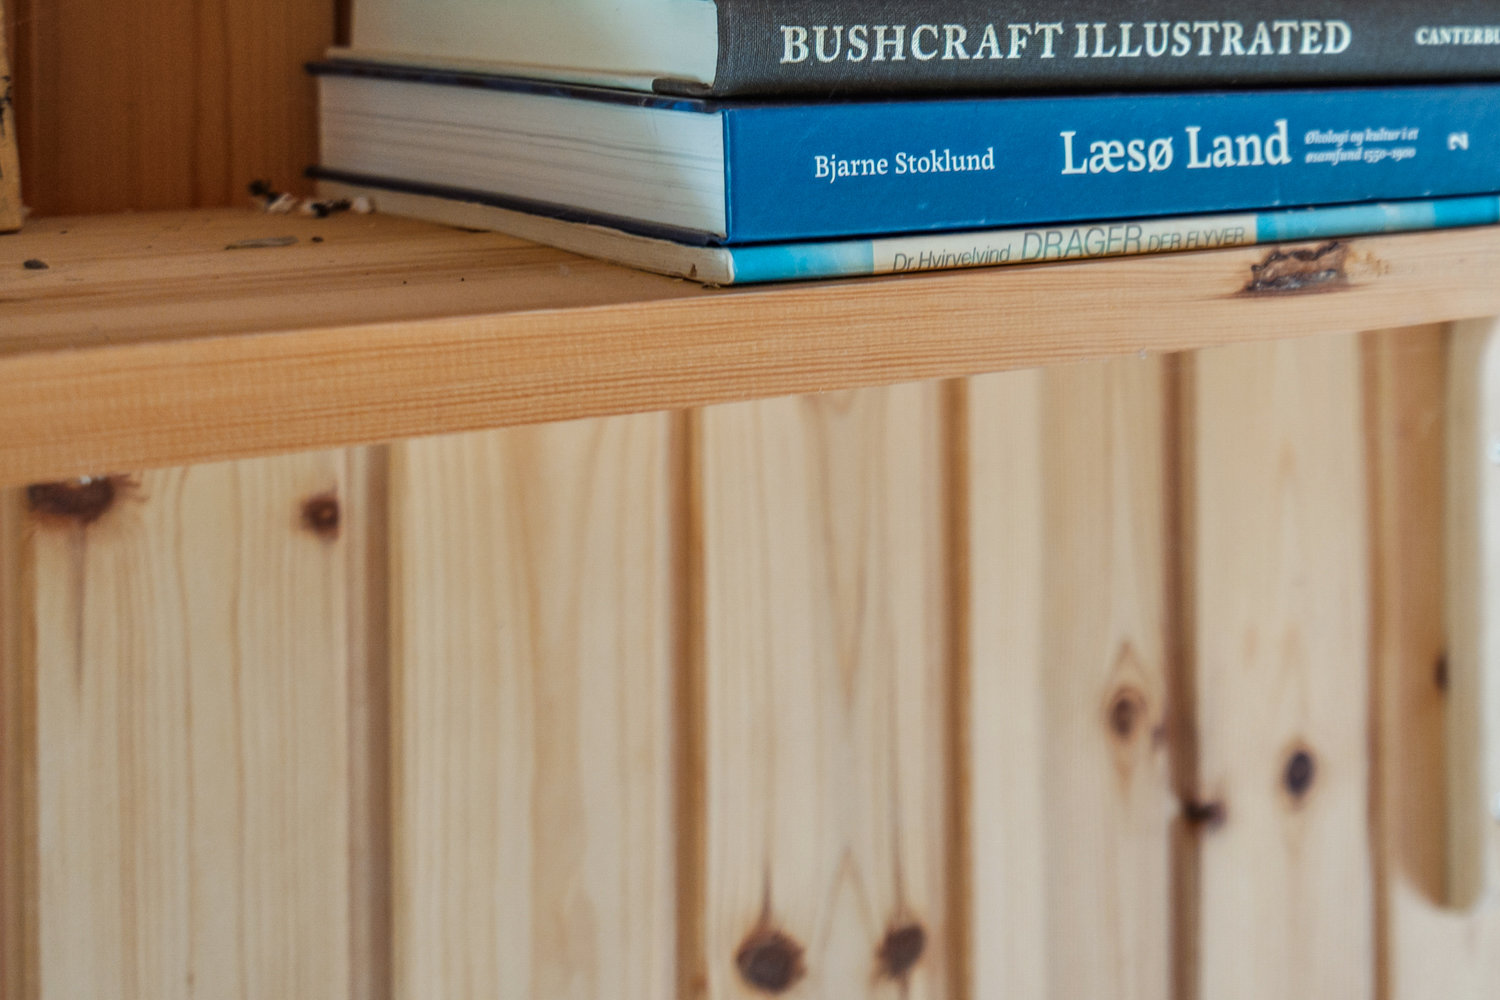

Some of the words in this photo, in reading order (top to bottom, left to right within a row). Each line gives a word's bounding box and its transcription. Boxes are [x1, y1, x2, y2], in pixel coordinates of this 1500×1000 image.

[780, 22, 1064, 63] BUSHCRAFT
[1073, 20, 1352, 58] ILLUSTRATED
[814, 154, 889, 184] Bjarne
[895, 147, 995, 175] Stoklund
[1059, 130, 1173, 175] Læsø
[1185, 119, 1292, 169] Land
[1304, 127, 1350, 148] Økologi
[1350, 130, 1364, 146] og
[1365, 127, 1401, 142] kultur
[1448, 131, 1469, 151] 2
[1304, 146, 1363, 166] øsamfund
[1022, 224, 1144, 262] DRAGER
[1149, 233, 1182, 252] DER
[1186, 226, 1246, 250] FLYVER
